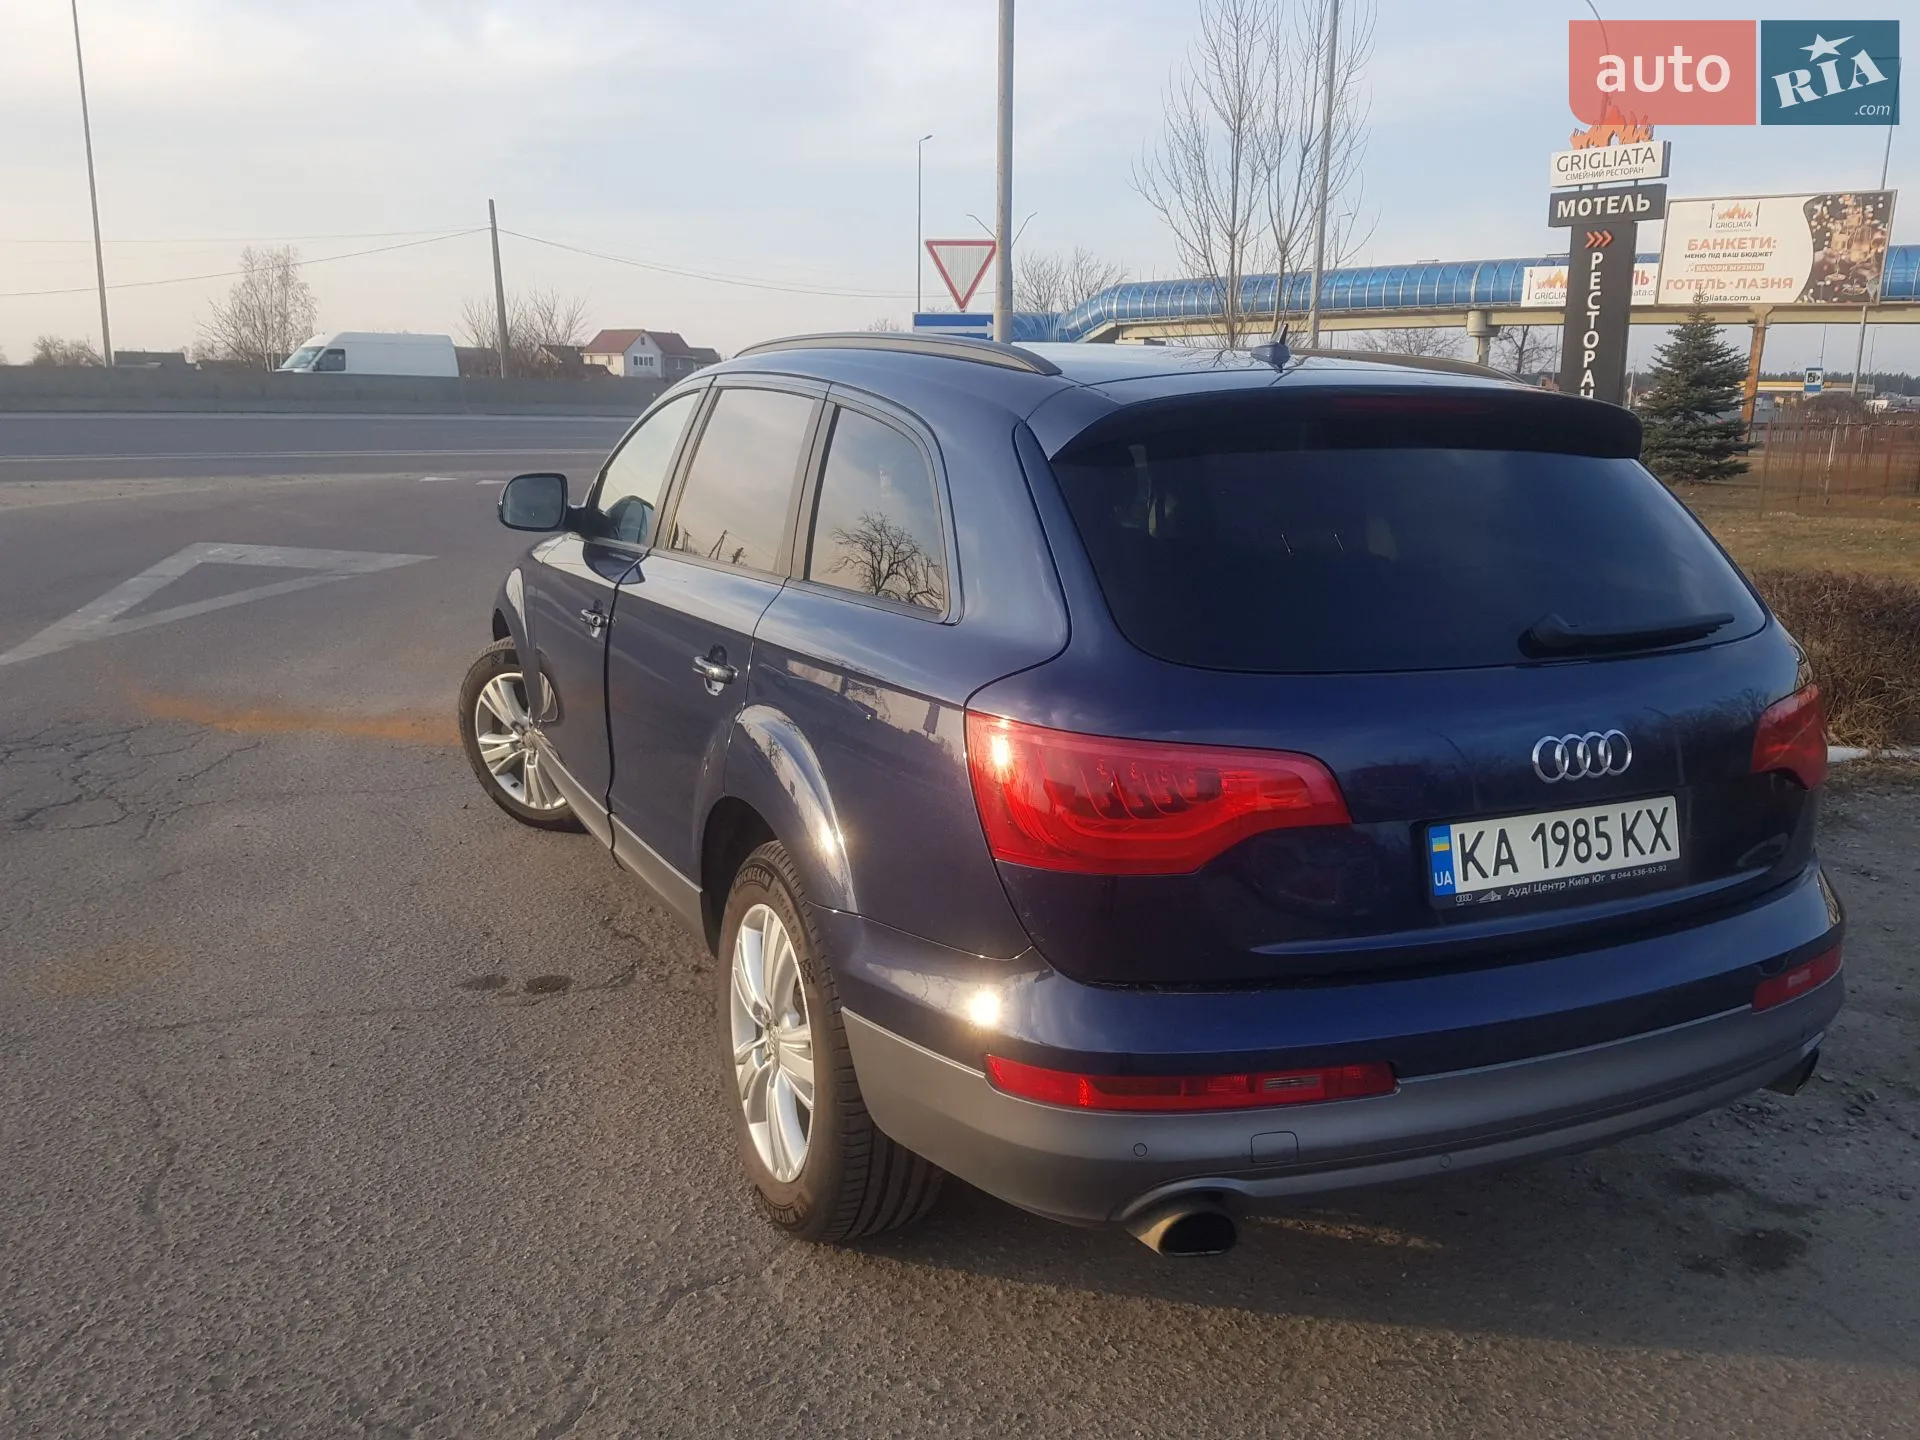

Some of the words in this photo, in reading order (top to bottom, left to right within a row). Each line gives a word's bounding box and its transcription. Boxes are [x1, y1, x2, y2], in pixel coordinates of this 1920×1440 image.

[1556, 147, 1656, 172] GRIGLIATA
[1565, 169, 1605, 181] СІМЕЙНИЙ
[1605, 167, 1644, 177] РЕСТОРАН
[1557, 193, 1651, 219] МОТЕЛЬ
[1715, 221, 1752, 229] GRIGLIATA
[1687, 236, 1778, 251] БАНКЕТИ:
[1665, 278, 1727, 290] ГОТЕЛЬ
[1735, 277, 1794, 289] ЛАЗНЯ
[1458, 828, 1519, 882] KA
[1531, 815, 1613, 870] 1985
[1621, 806, 1672, 858] KX
[734, 867, 771, 890] MICHELIN
[1434, 870, 1453, 886] UA
[1507, 884, 1531, 897] Ауді
[1533, 880, 1566, 893] Центр
[1568, 876, 1590, 887] Київ
[1592, 873, 1606, 884] Юг
